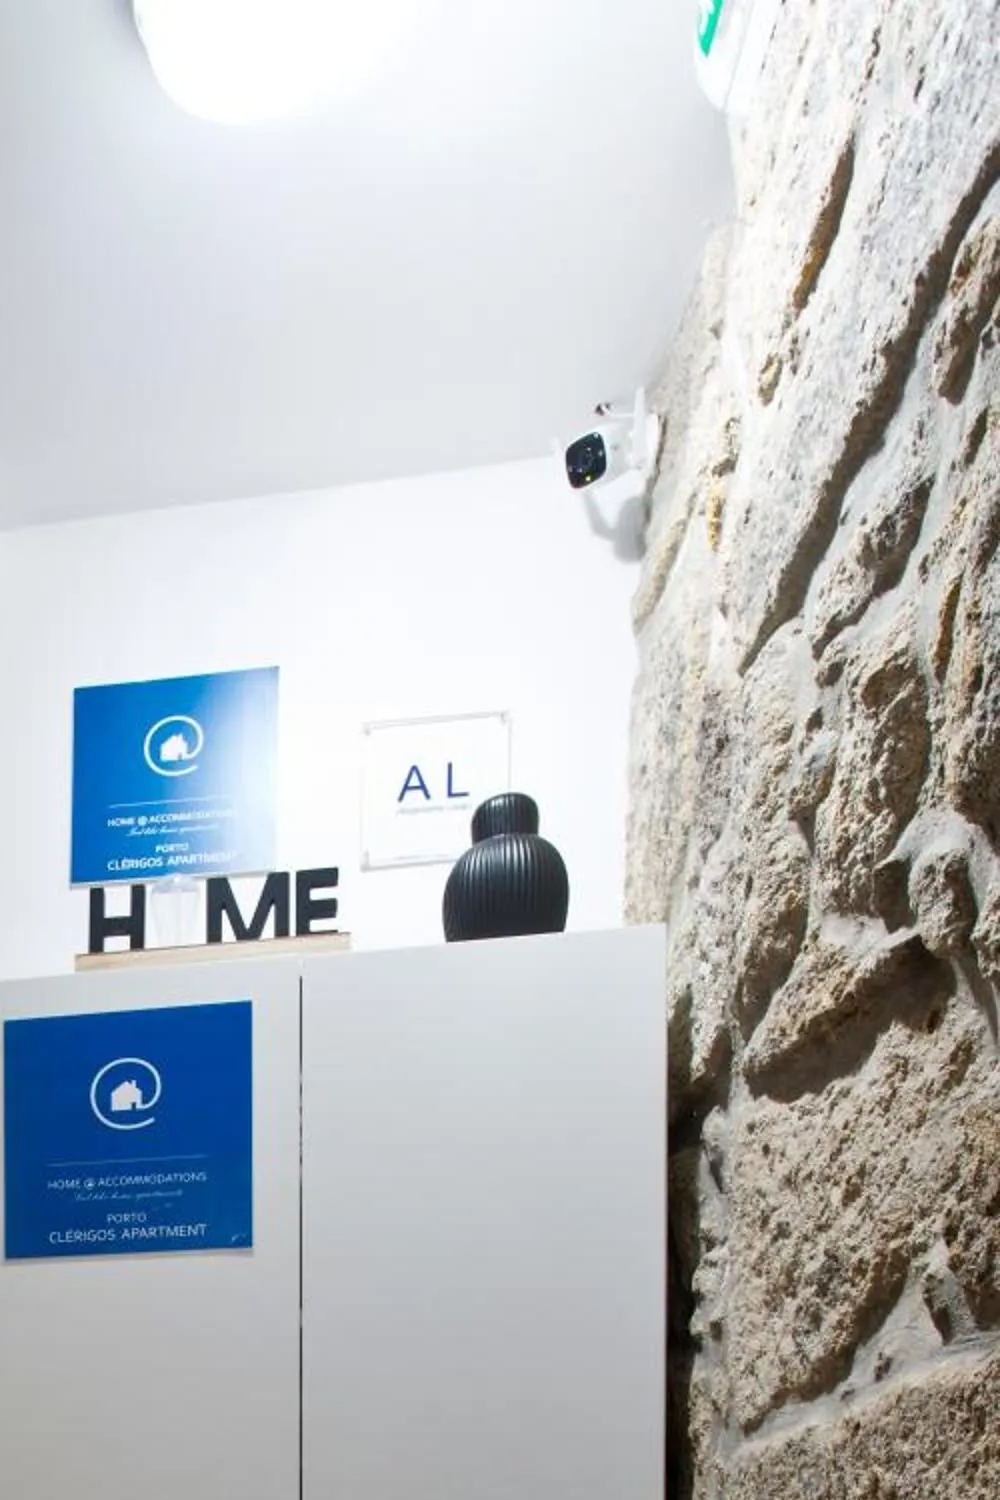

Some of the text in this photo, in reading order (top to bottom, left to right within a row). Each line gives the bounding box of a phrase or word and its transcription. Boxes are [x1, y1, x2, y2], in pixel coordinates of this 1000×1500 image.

[107, 815, 136, 827] HOME
[155, 842, 189, 853] PORTO
[89, 866, 339, 954] HME
[48, 1178, 81, 1191] HOME
[98, 1172, 208, 1187] ACCOMMODATIONS
[106, 1212, 147, 1224] PORTO
[121, 1223, 208, 1240] APARTMENT
